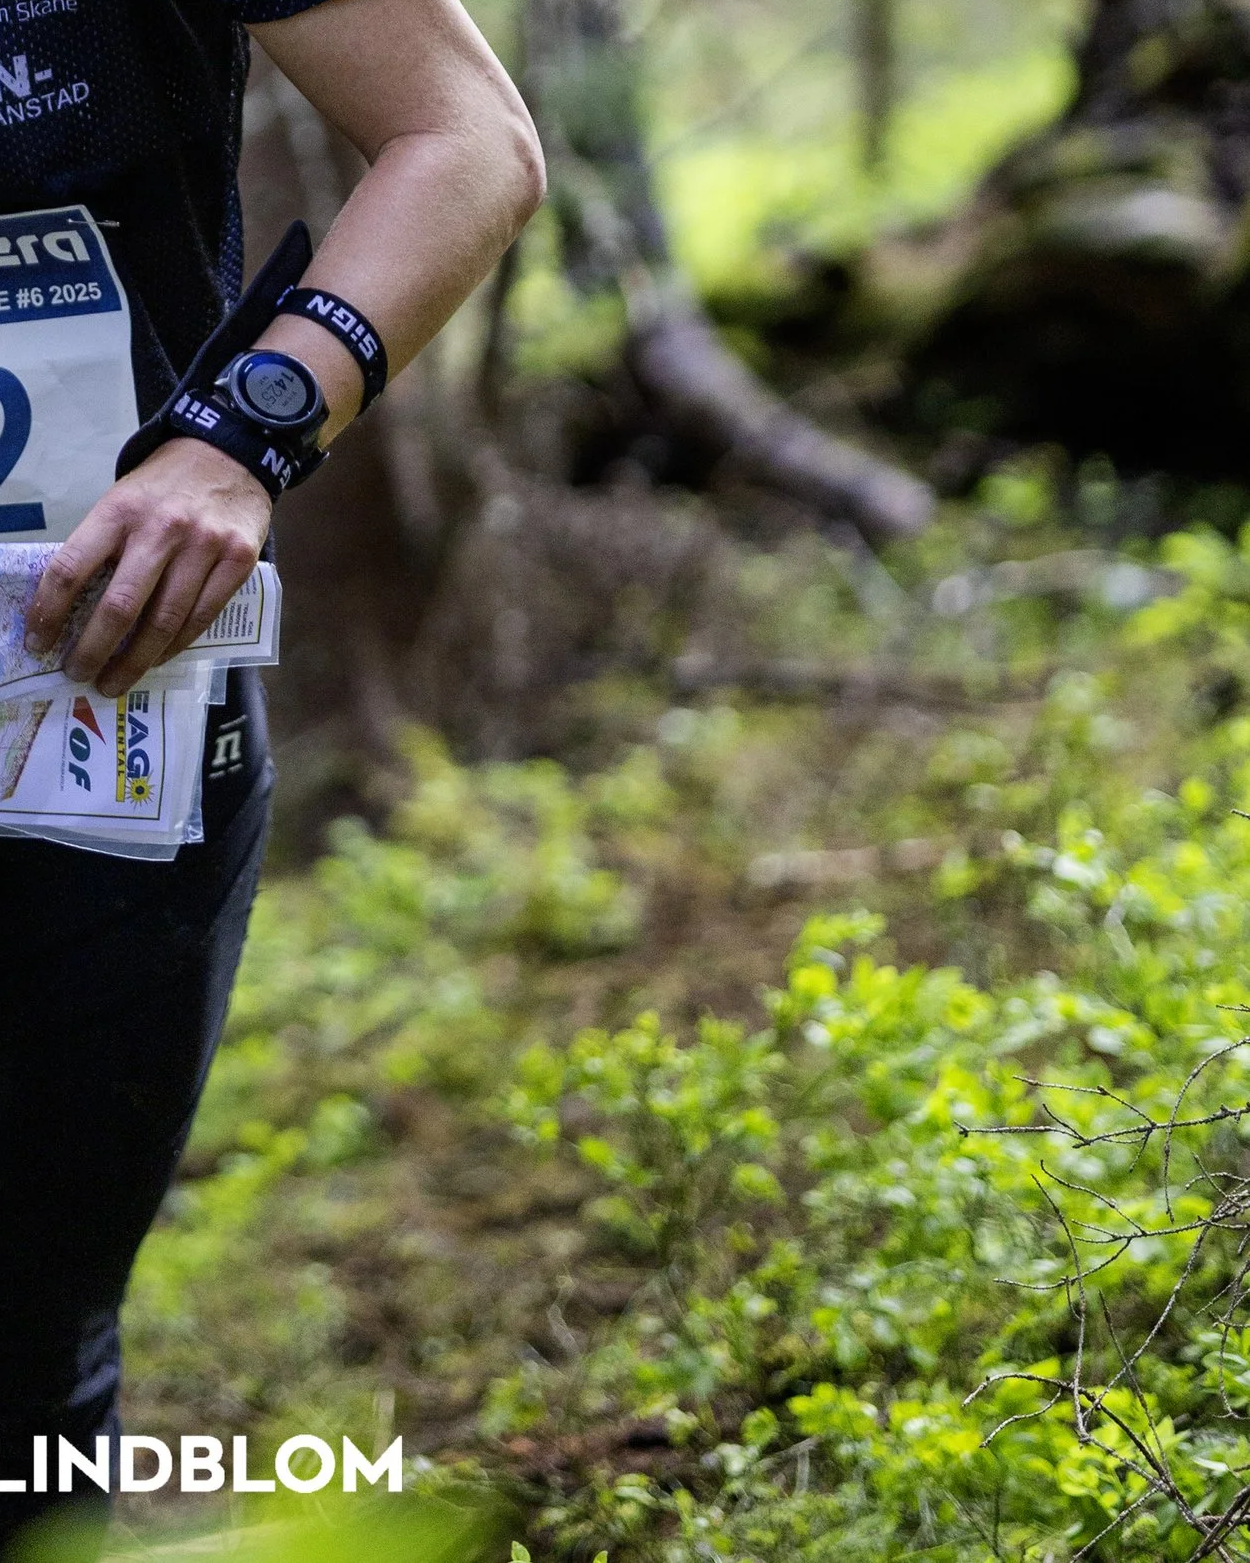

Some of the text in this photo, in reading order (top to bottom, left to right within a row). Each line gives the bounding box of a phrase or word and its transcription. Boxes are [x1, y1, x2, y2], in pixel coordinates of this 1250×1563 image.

[16, 287, 44, 309] #6
[49, 281, 102, 305] 2025
[118, 713, 126, 777] RENTAL
